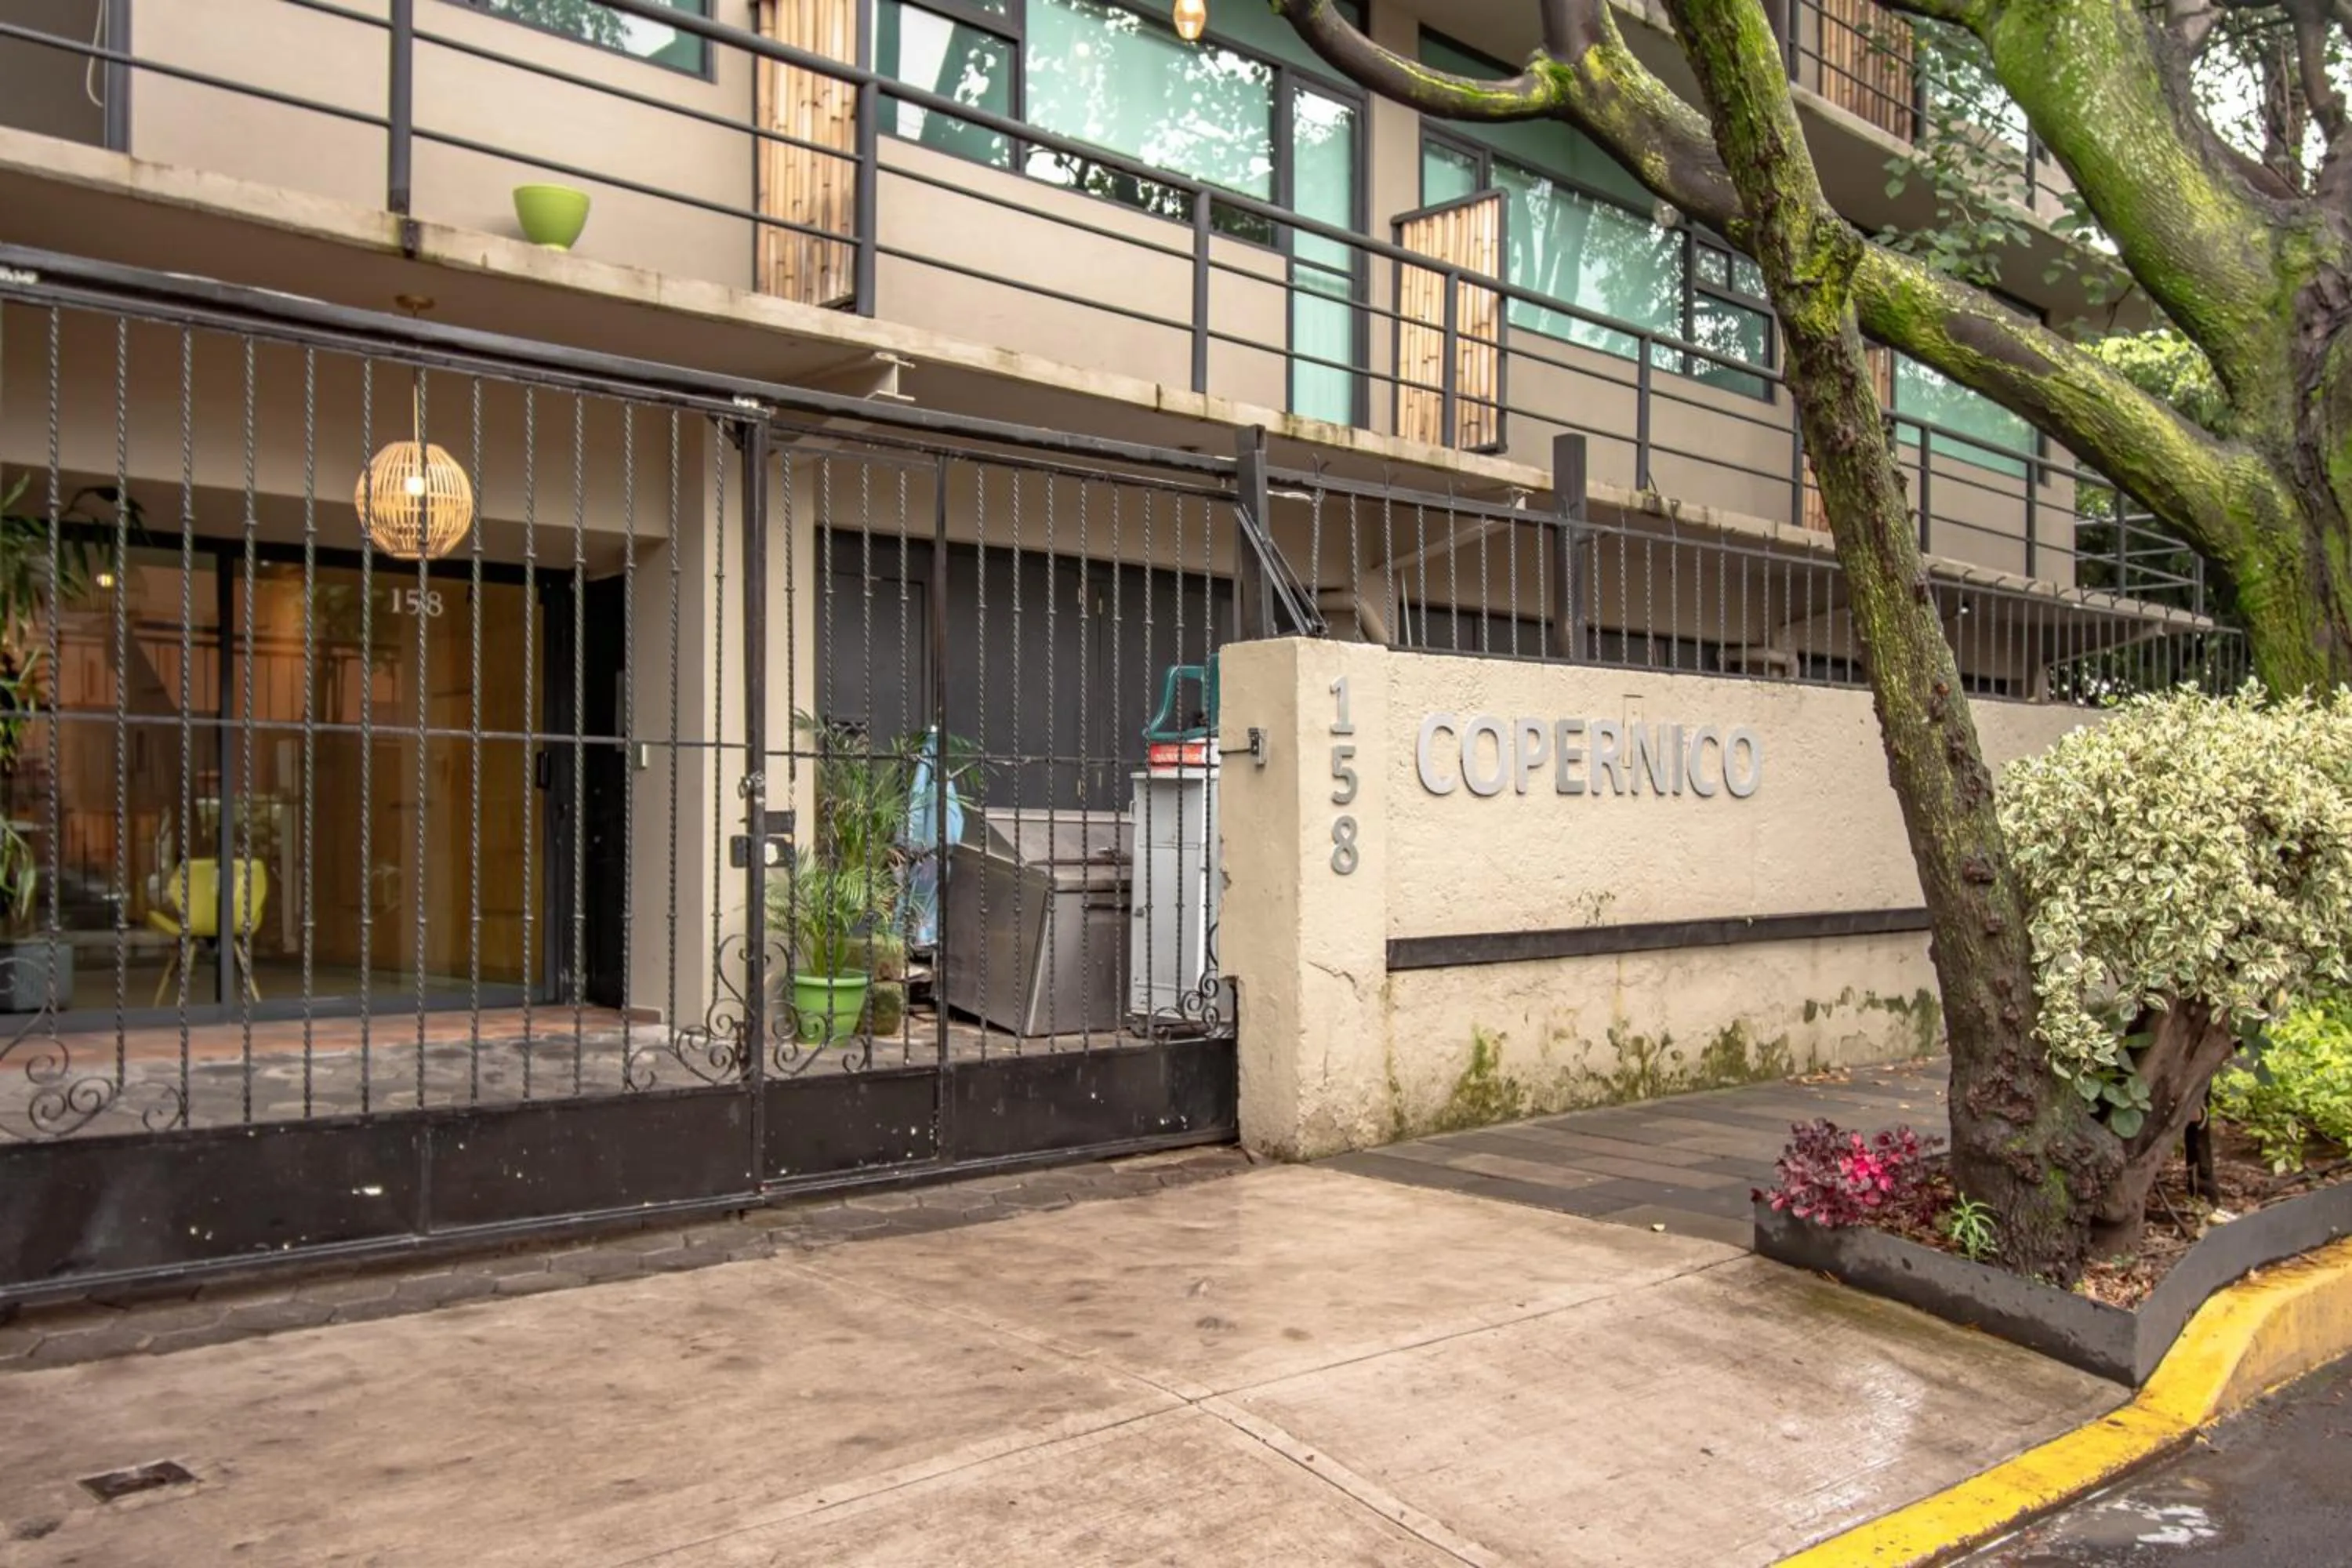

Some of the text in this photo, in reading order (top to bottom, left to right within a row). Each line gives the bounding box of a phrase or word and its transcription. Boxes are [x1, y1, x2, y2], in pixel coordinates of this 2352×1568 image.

[391, 587, 444, 617] 158
[1330, 676, 1359, 876] 158
[1416, 712, 1762, 798] COPERNICO
